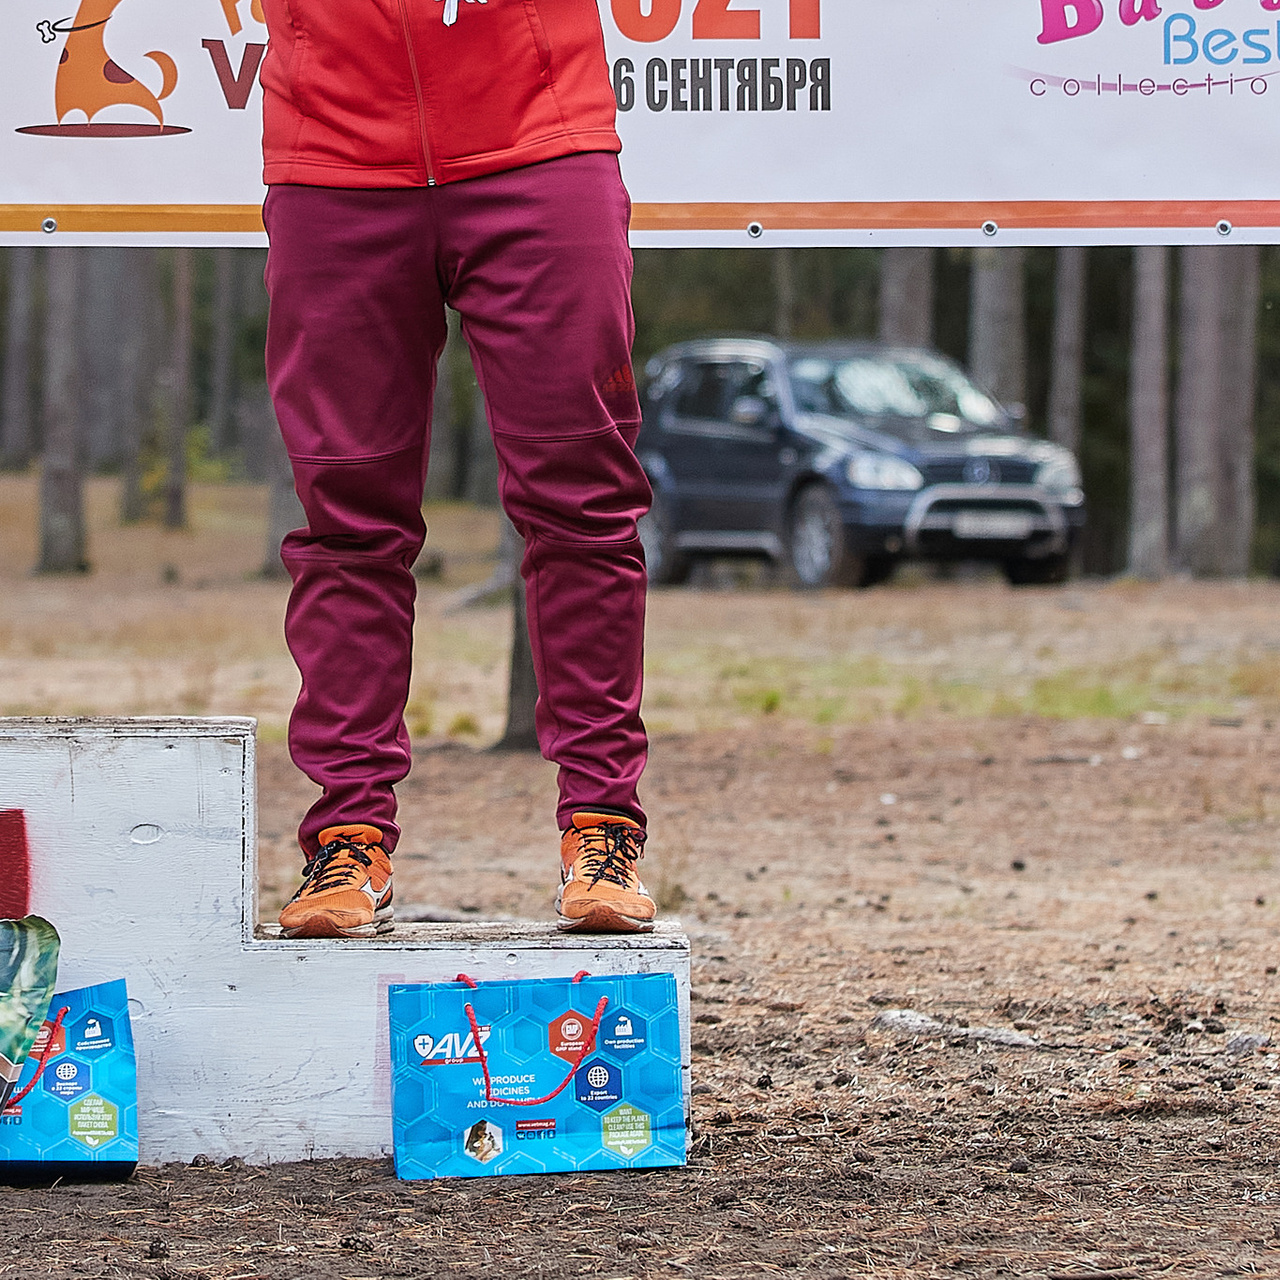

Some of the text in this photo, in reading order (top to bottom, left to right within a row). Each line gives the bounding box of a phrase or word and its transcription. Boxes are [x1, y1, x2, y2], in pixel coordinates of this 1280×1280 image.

[1163, 13, 1280, 65] Bes
[646, 58, 831, 111] СЕНТЯБРЯ
[425, 1031, 491, 1059] AVZ
[490, 1074, 536, 1085] PRODUCE
[467, 1100, 488, 1109] AND
